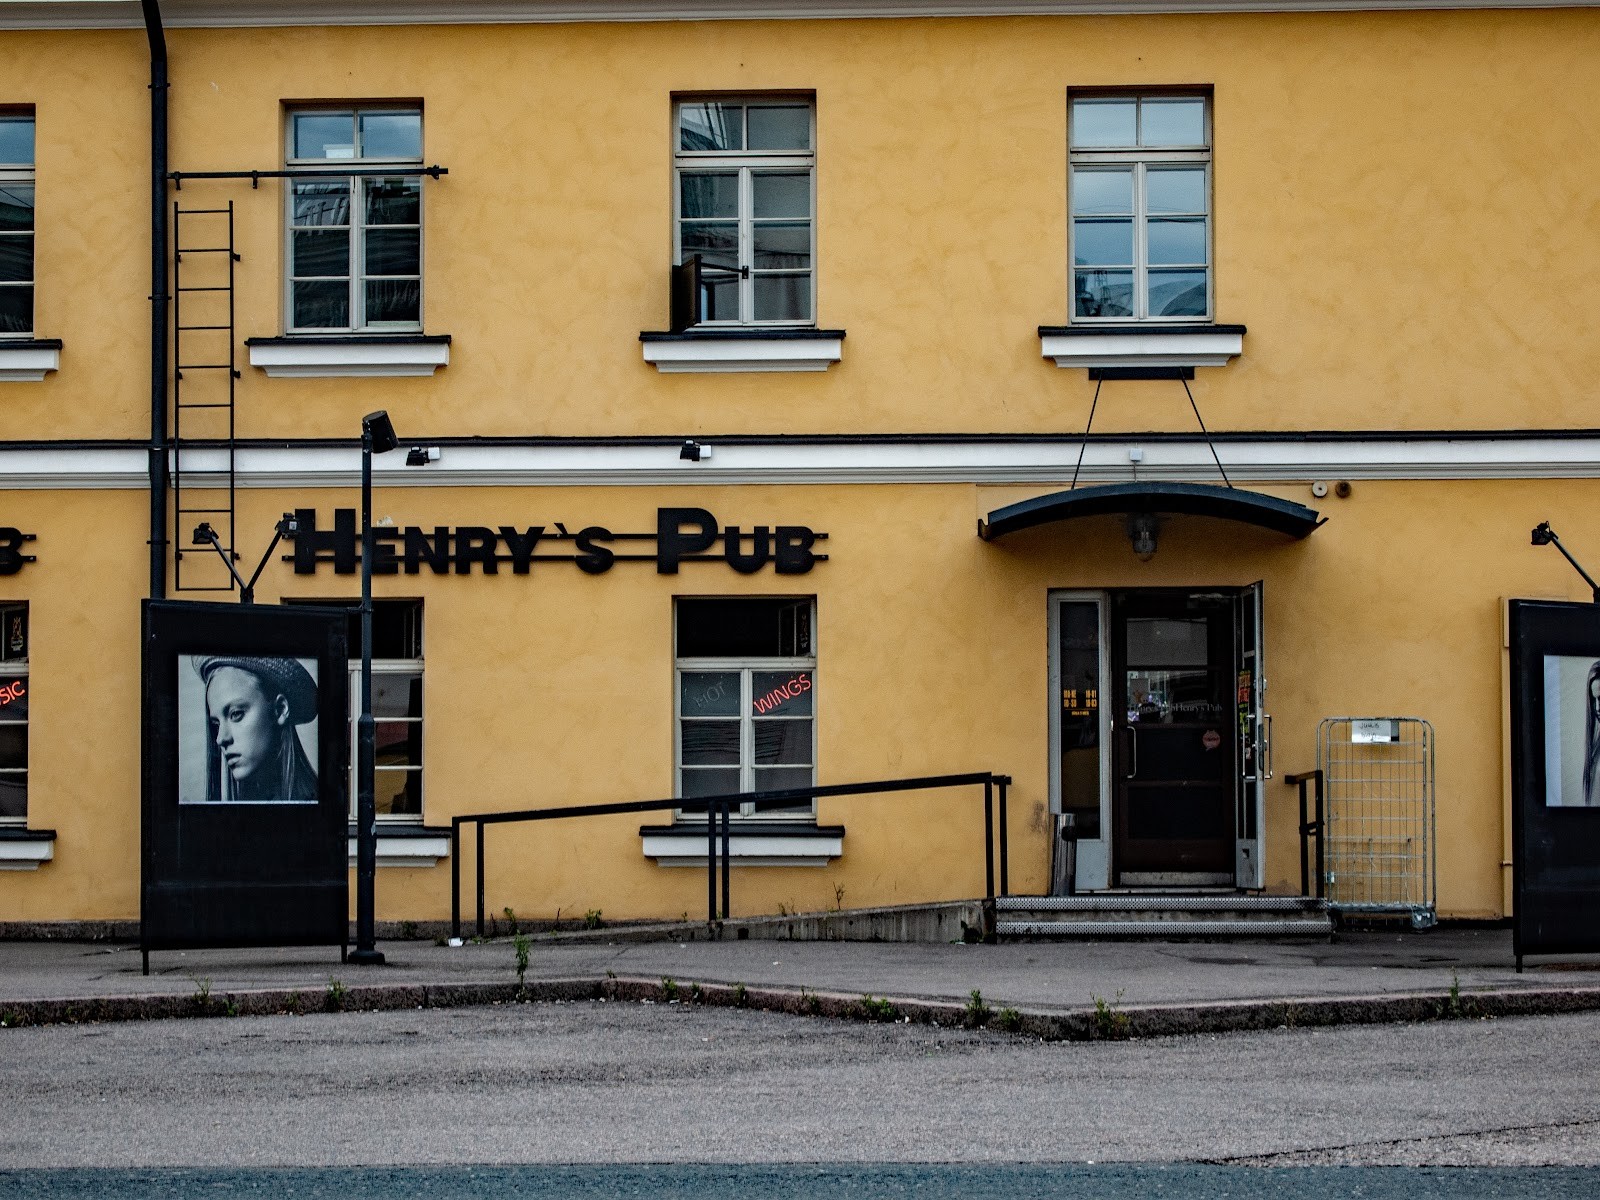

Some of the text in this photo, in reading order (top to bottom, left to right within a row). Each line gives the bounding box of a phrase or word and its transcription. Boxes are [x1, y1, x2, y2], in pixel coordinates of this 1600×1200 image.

[657, 507, 815, 574] PUB
[0, 681, 25, 706] SIC
[691, 673, 811, 714] HOT WINGS
